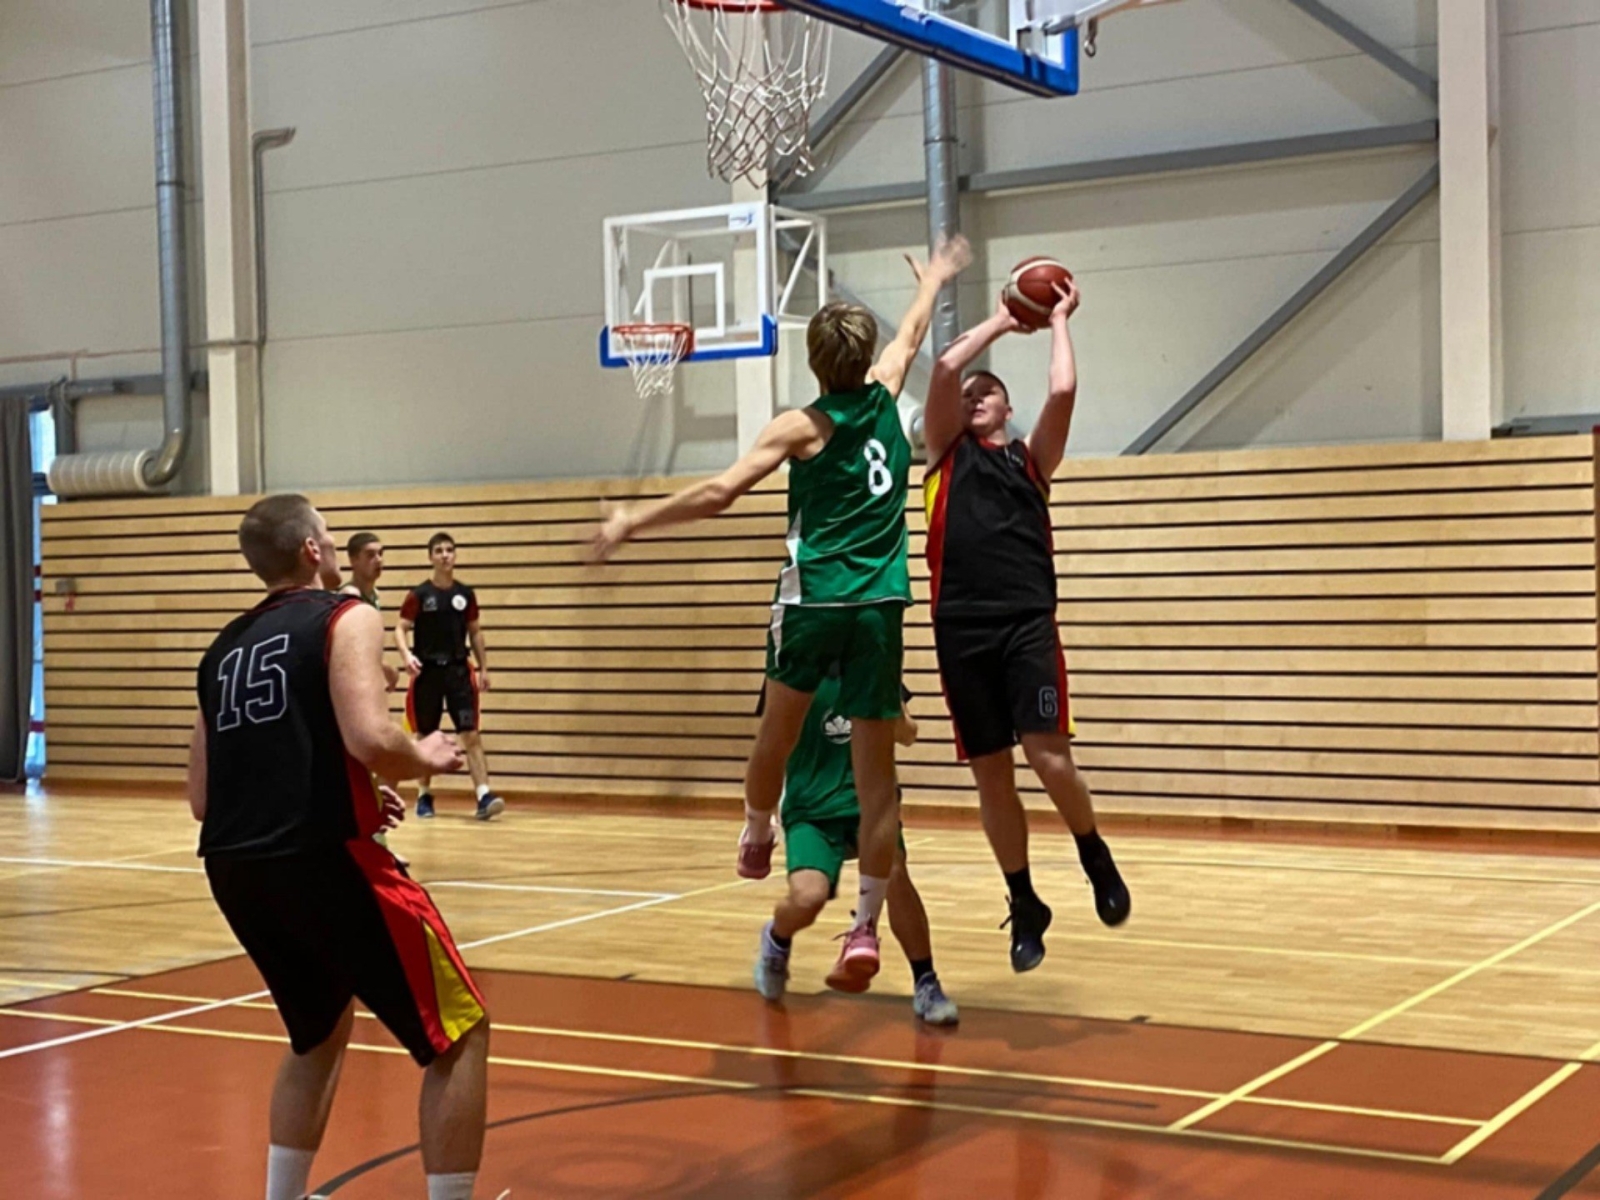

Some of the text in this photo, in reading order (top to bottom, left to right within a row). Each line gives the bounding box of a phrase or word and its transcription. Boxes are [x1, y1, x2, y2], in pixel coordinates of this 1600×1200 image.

[863, 438, 893, 496] 8
[217, 633, 289, 732] 15
[1038, 685, 1058, 718] 6
